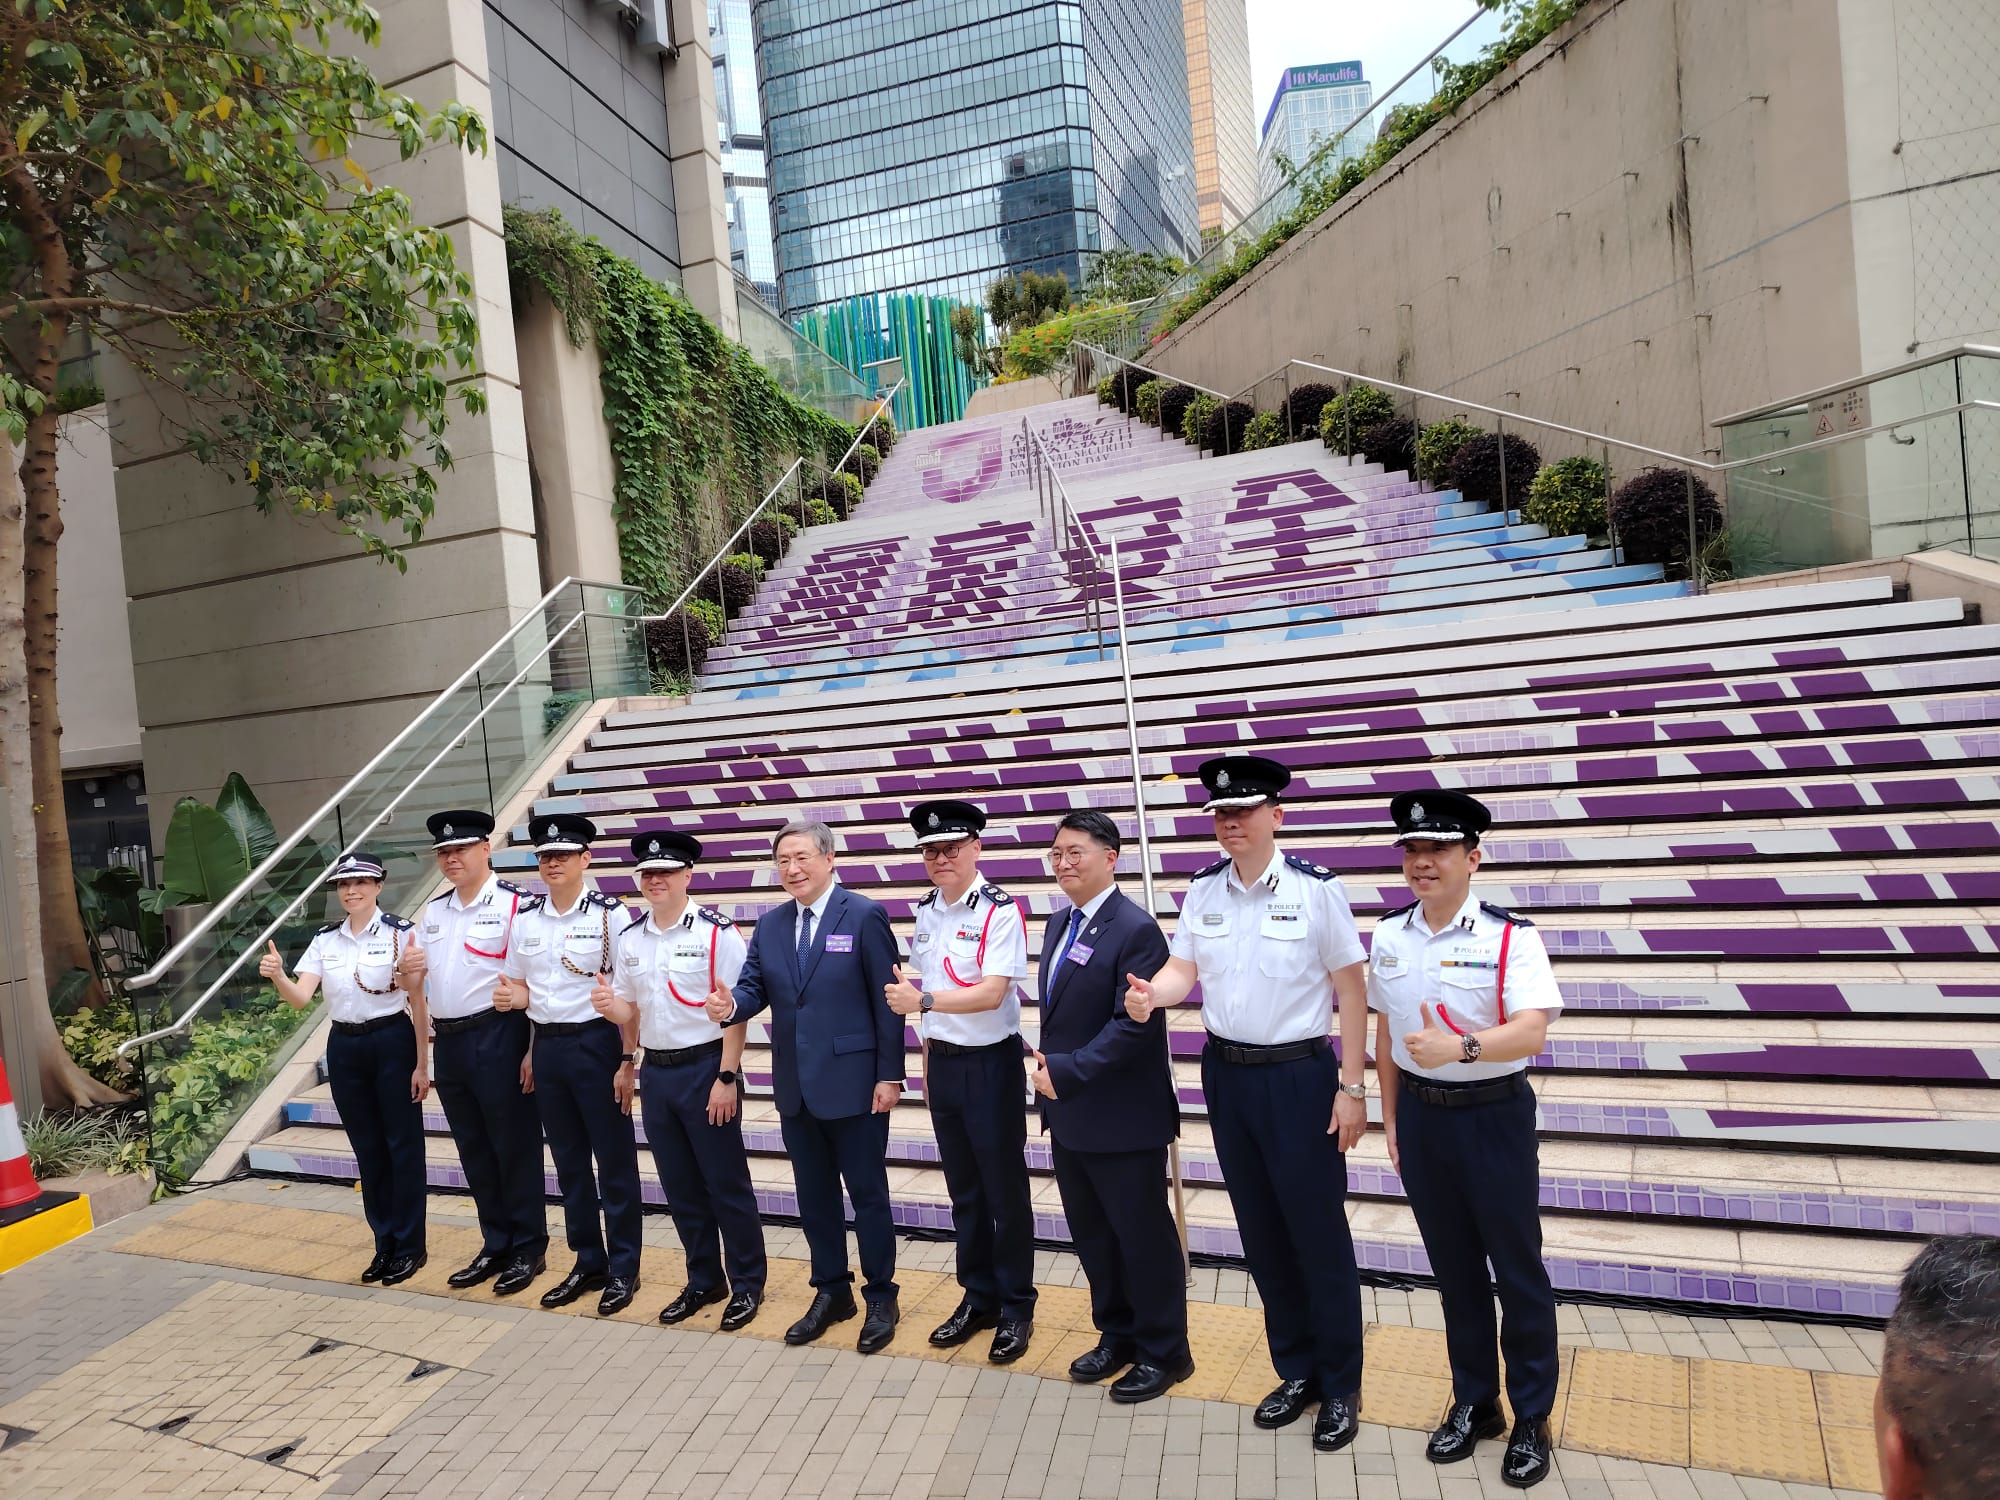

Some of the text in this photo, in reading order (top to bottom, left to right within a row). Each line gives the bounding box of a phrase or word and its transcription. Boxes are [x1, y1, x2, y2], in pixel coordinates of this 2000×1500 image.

[1307, 67, 1358, 83] Manulife
[1010, 440, 1132, 470] NAIONAL SECURITY
[1010, 453, 1109, 478] EDCAION DAY
[740, 468, 1362, 651] 國家安全
